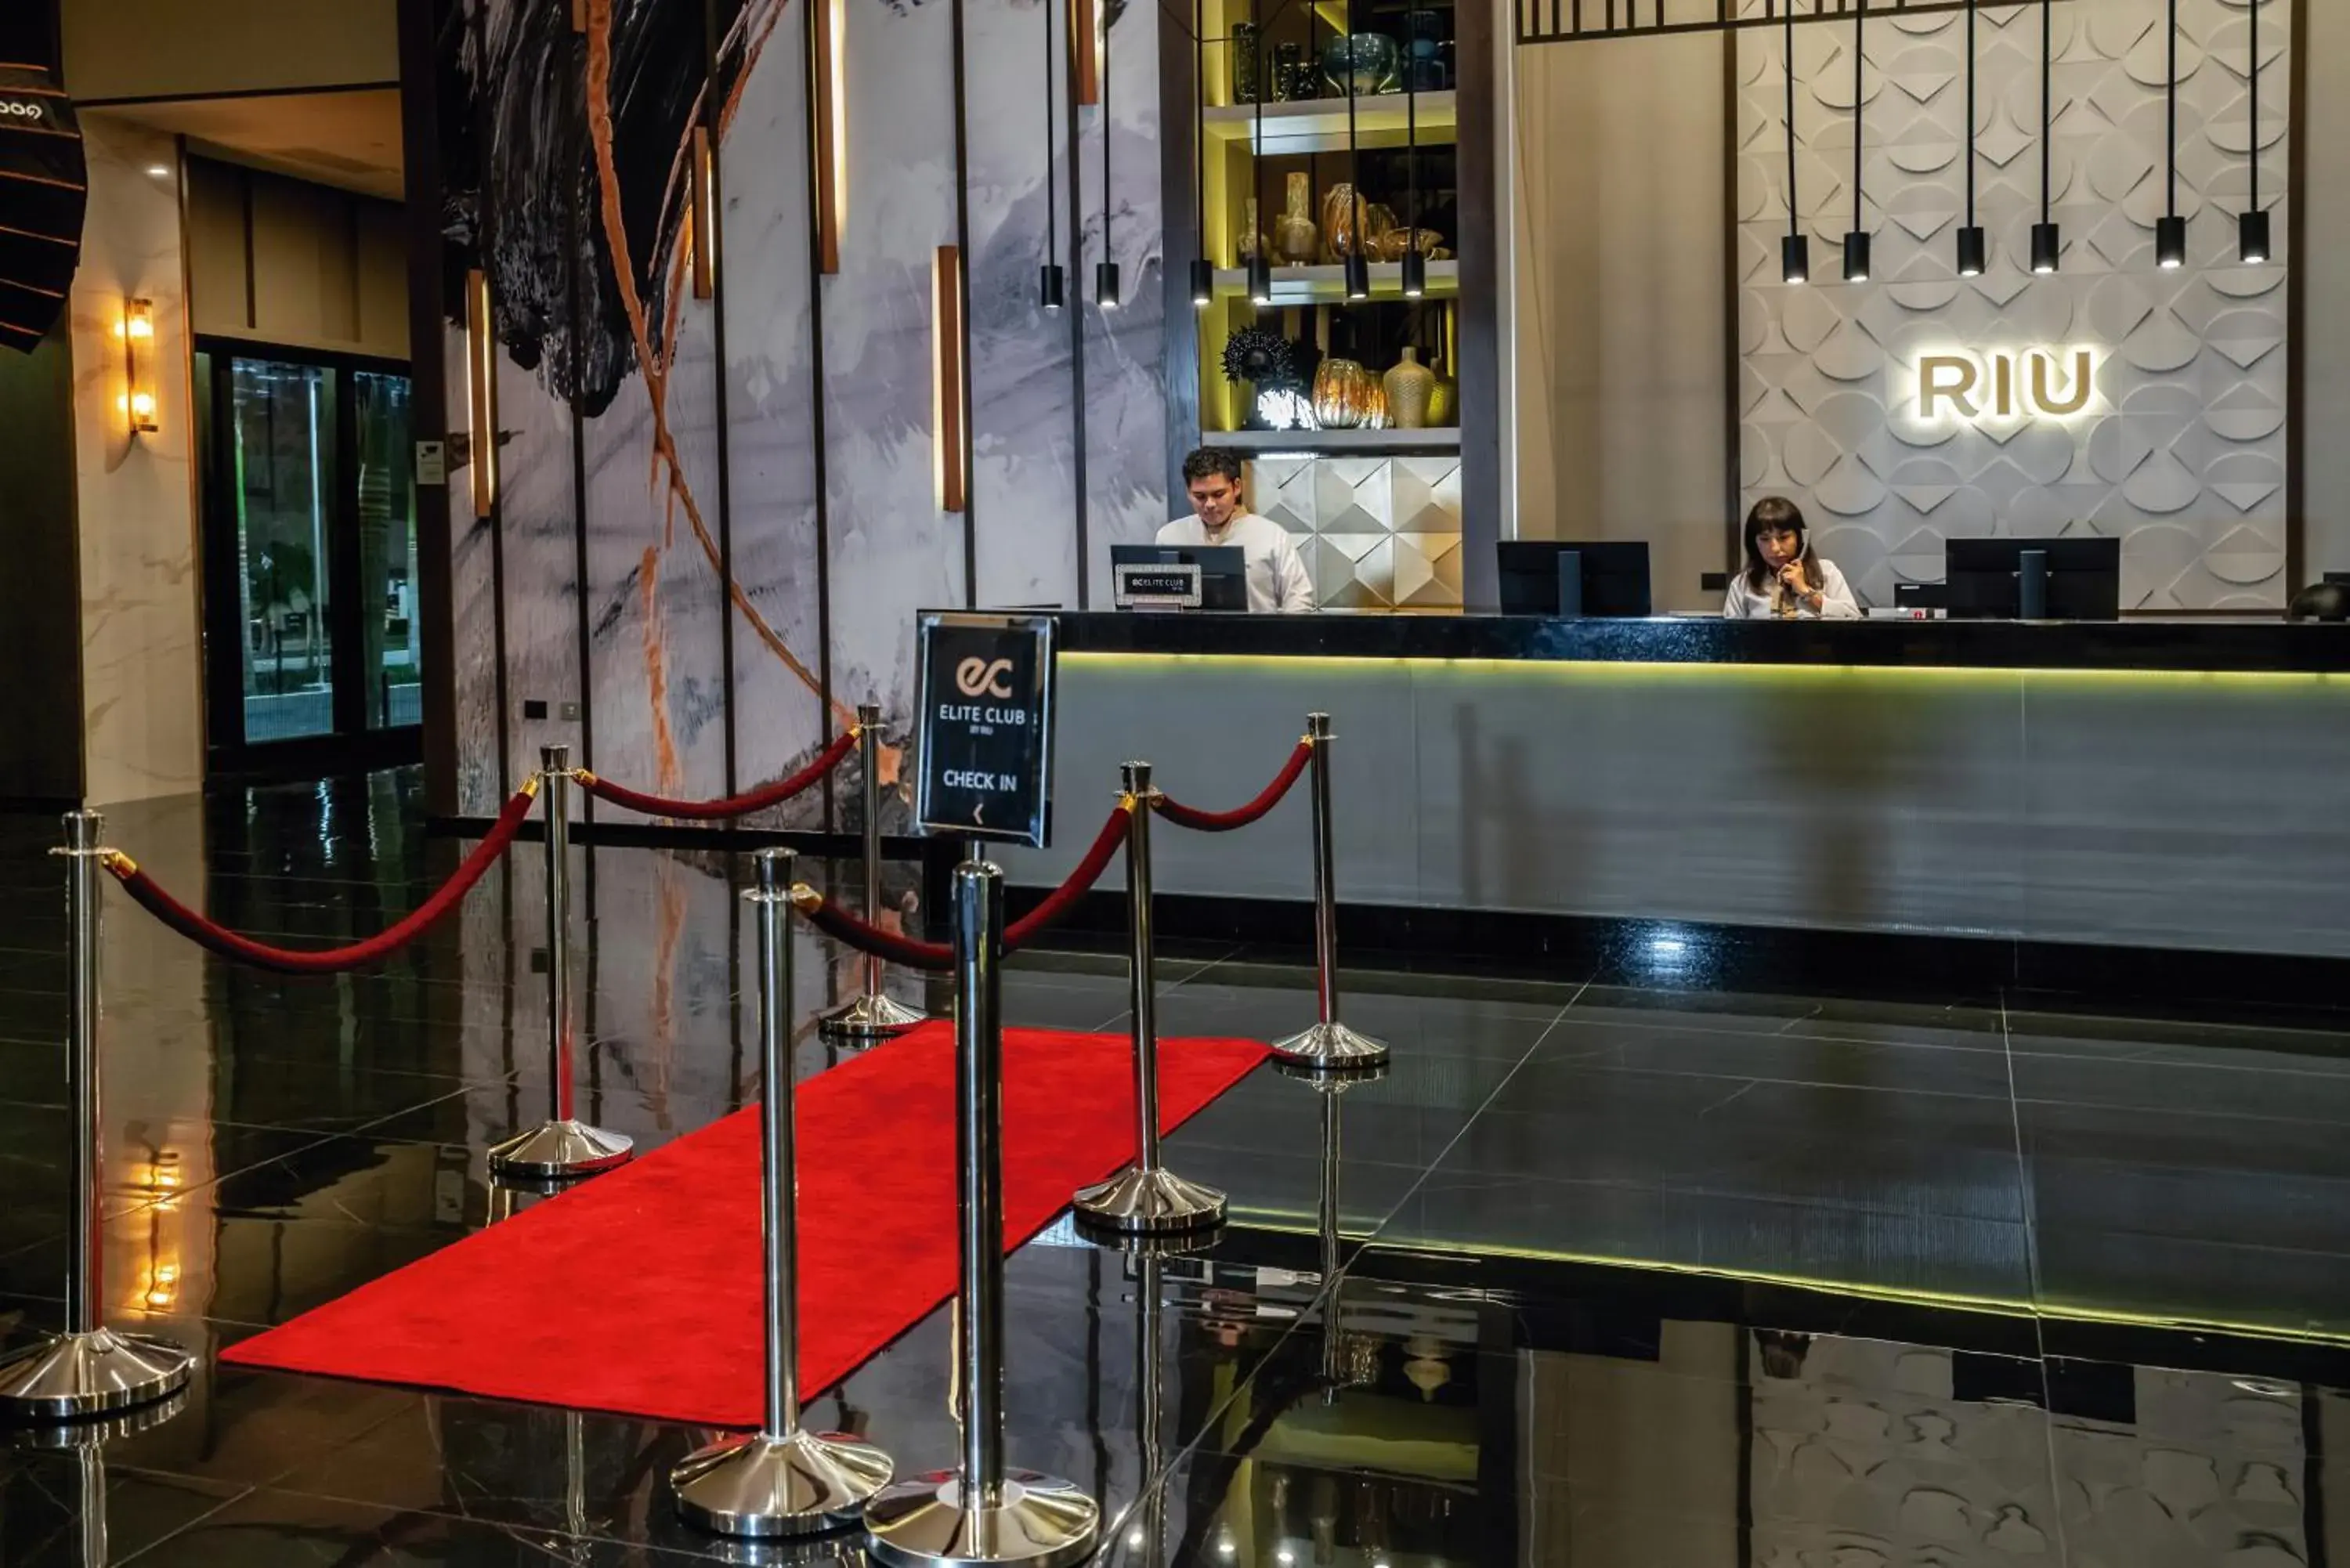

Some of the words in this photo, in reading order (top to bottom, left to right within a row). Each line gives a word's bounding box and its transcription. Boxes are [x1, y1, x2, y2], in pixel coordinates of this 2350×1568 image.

[1920, 351, 2091, 417] RIU
[939, 704, 982, 723] ELITE
[985, 708, 1026, 724] CLUB
[943, 769, 994, 790] CHECK
[1000, 774, 1017, 792] IN
